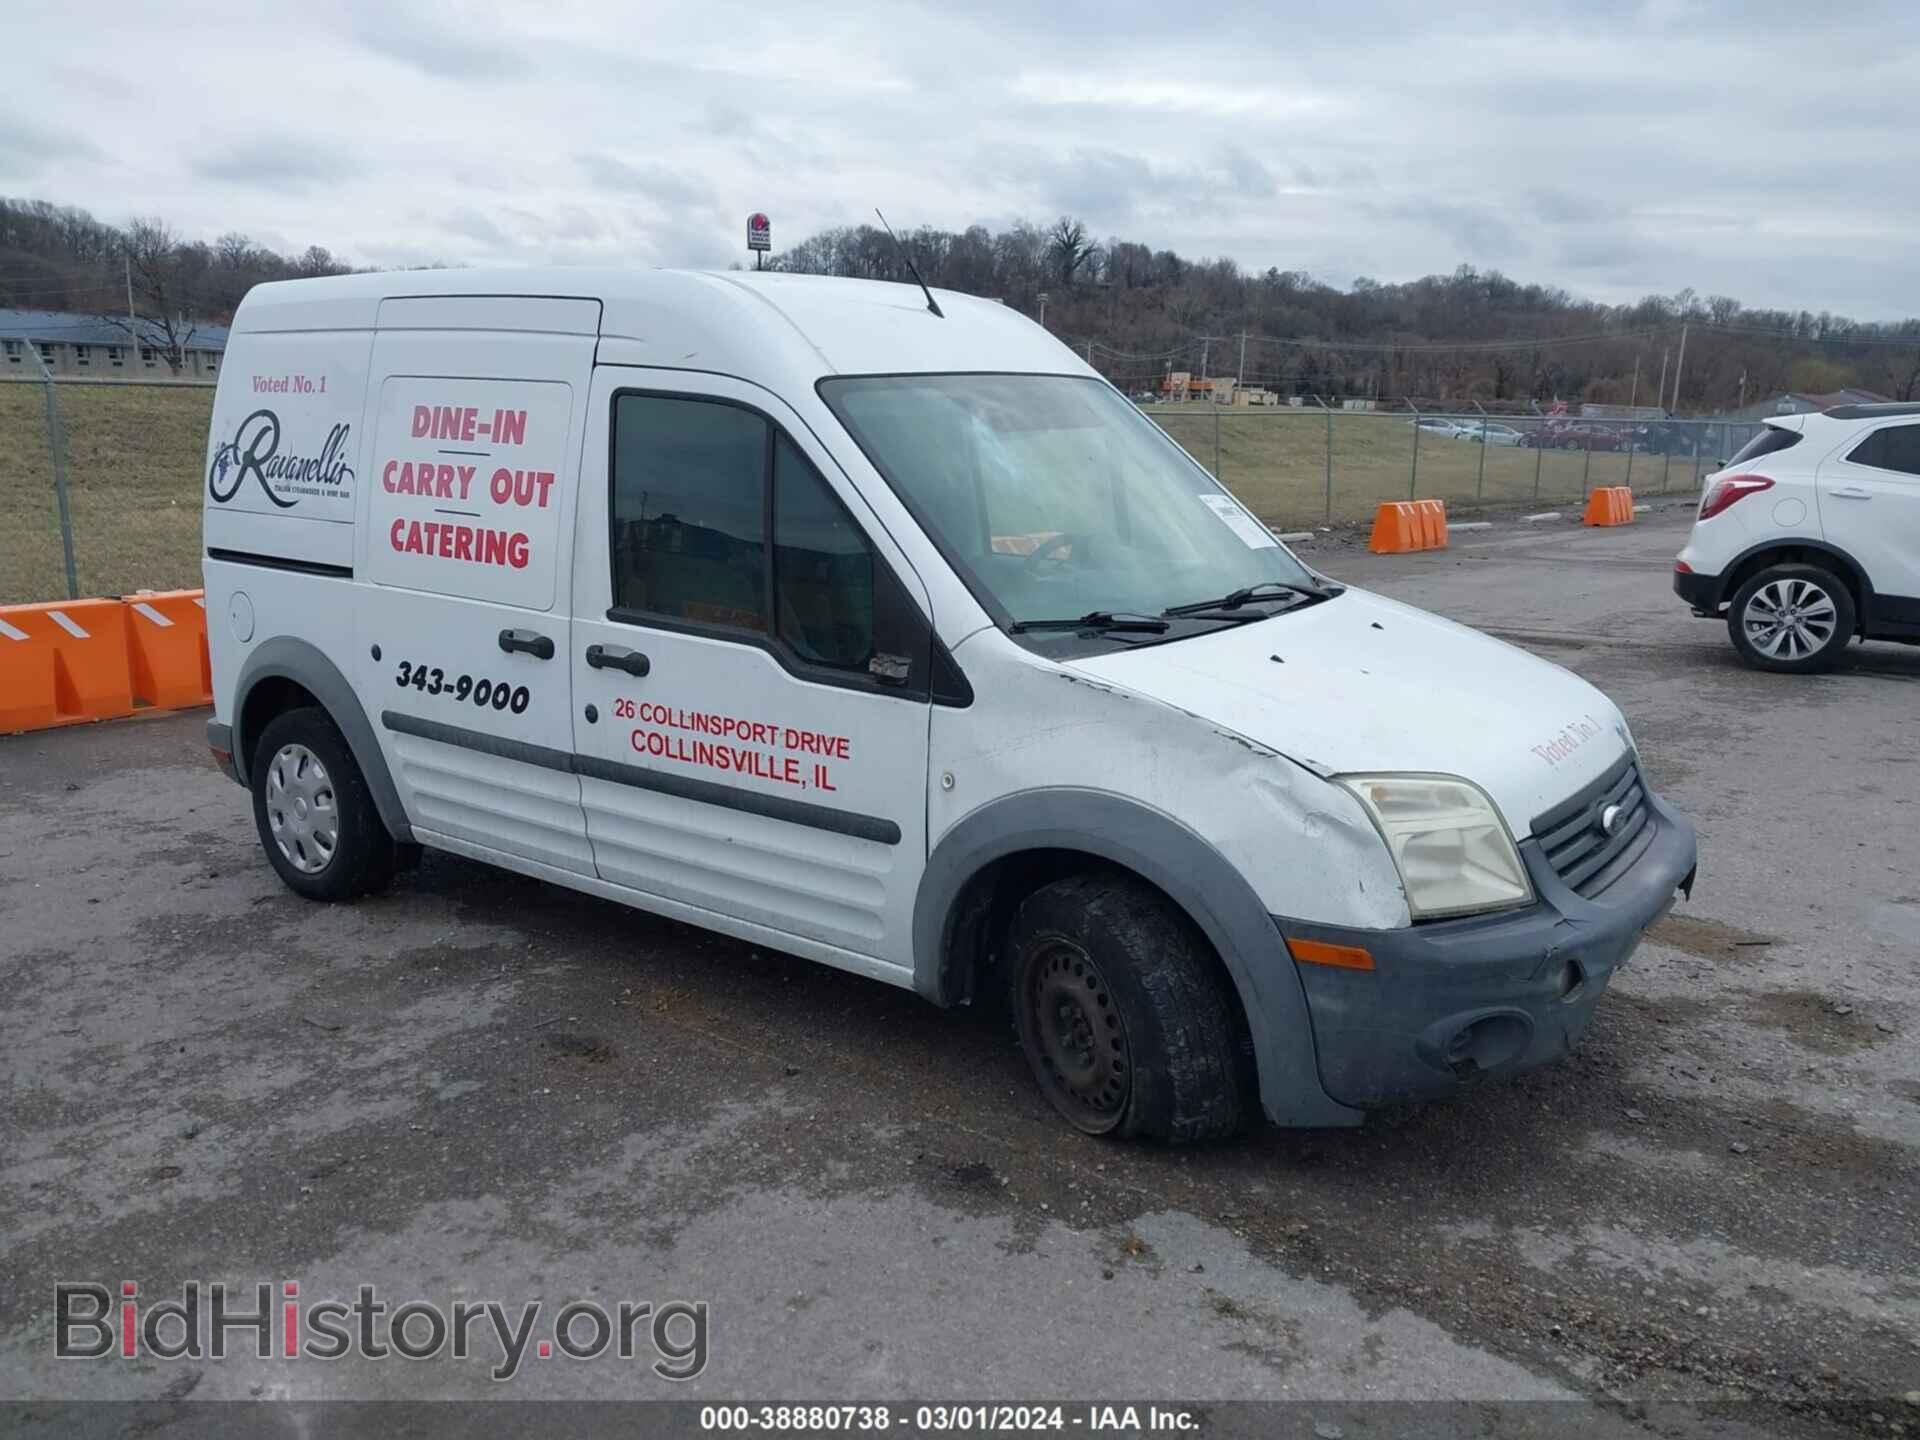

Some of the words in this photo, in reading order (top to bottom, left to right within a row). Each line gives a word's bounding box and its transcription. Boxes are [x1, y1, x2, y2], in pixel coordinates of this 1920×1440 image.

[252, 375, 289, 393] Voted
[293, 375, 316, 393] No.
[319, 375, 326, 393] 1
[411, 405, 527, 445] DINE-IN
[382, 460, 477, 500] CARRY
[490, 467, 555, 508] OUT
[390, 518, 529, 569] CATERING
[396, 660, 530, 714] 343-9000
[615, 698, 635, 719] 26
[639, 702, 779, 746] COLLINSPORT
[785, 728, 850, 760] DRIVE
[1531, 730, 1579, 766] Voted
[631, 729, 807, 789] COLLINSVILLE,
[814, 764, 837, 791] IL
